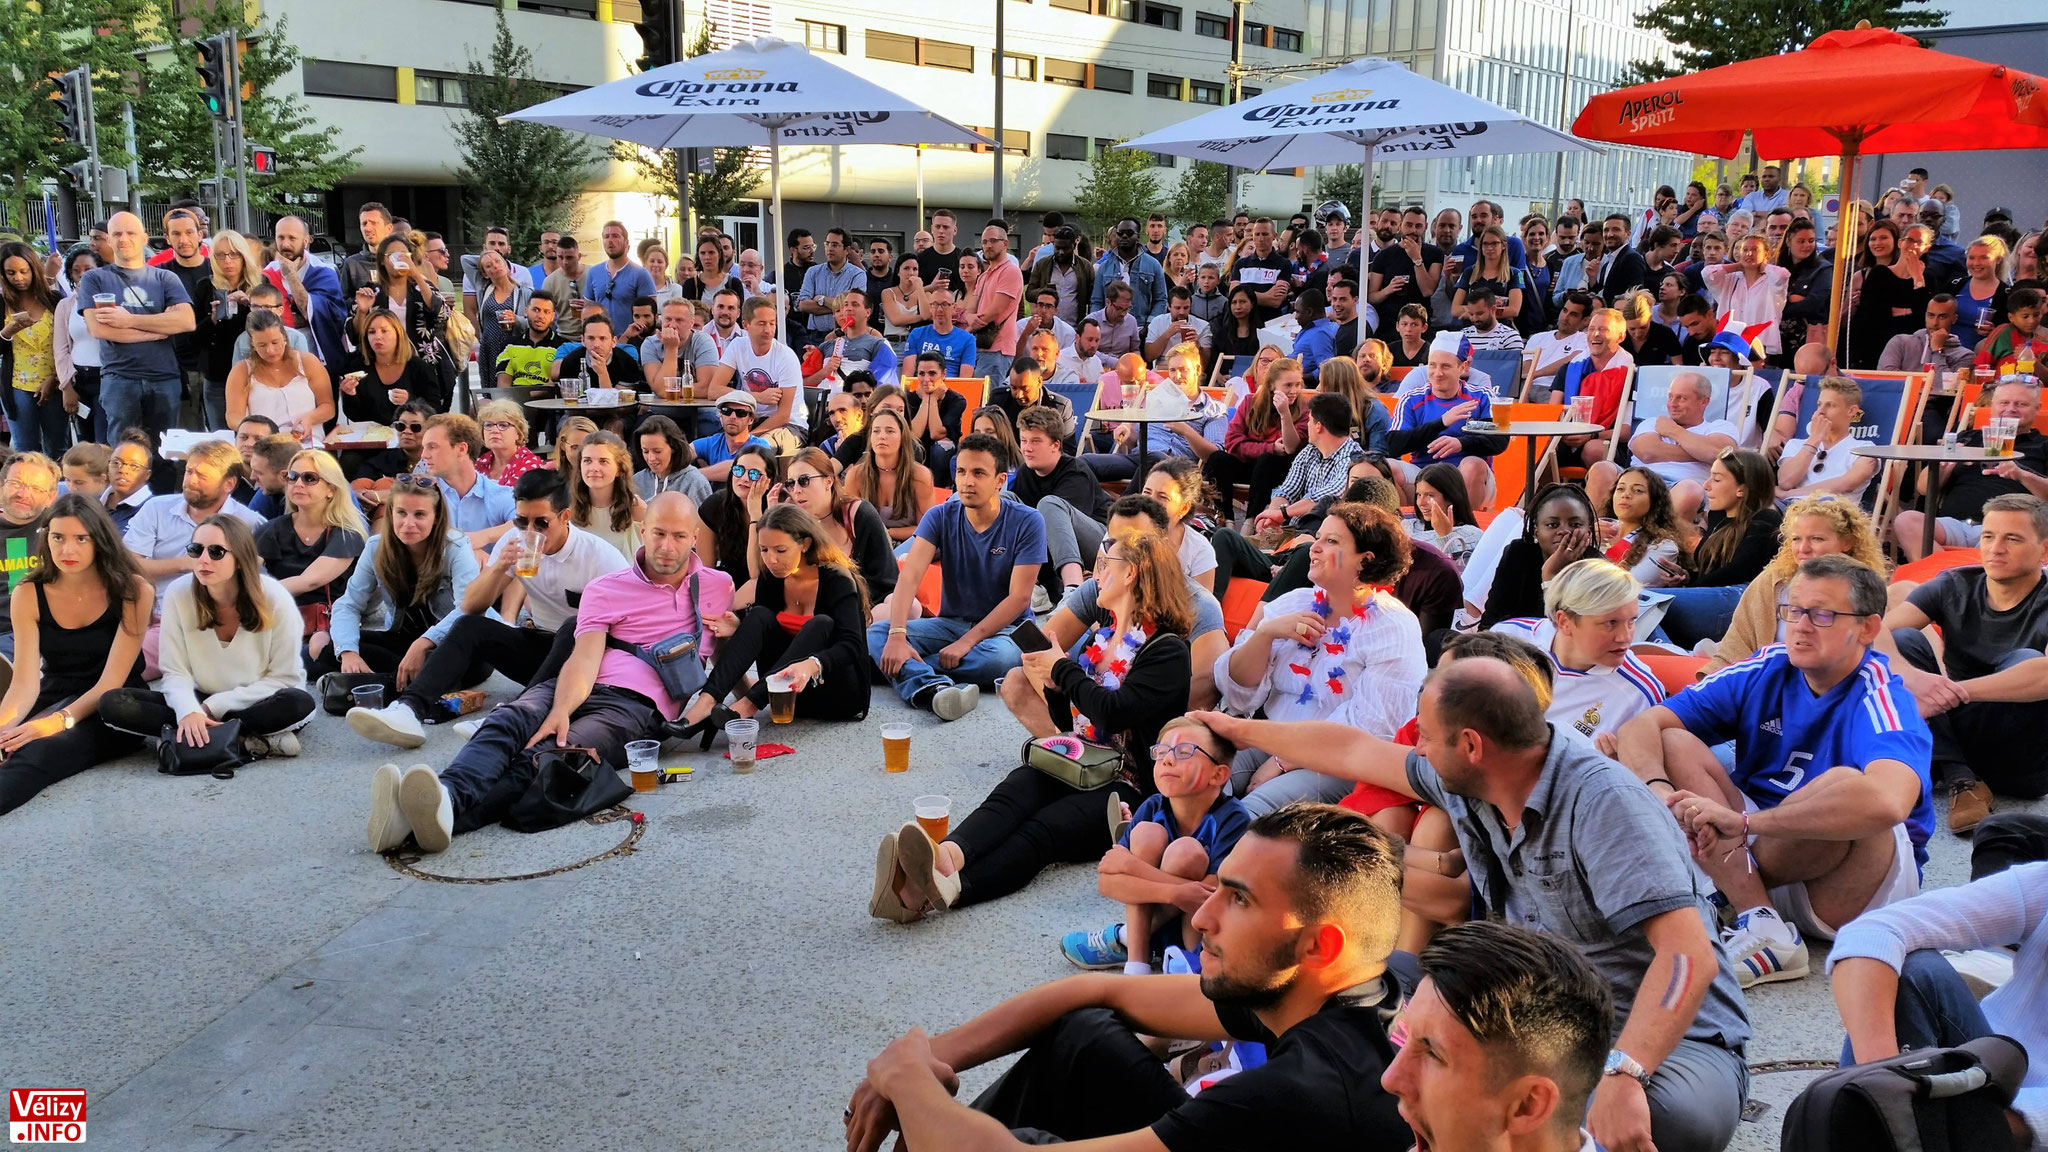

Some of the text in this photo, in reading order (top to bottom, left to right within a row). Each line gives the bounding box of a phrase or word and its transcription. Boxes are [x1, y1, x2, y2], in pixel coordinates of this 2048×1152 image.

[635, 79, 799, 99] Corona
[673, 95, 760, 107] Extra
[1242, 99, 1401, 122] Corona
[1619, 89, 1684, 124] APEROL
[1271, 117, 1356, 129] Extra
[922, 341, 940, 351] FRA
[1768, 751, 1814, 792] 5
